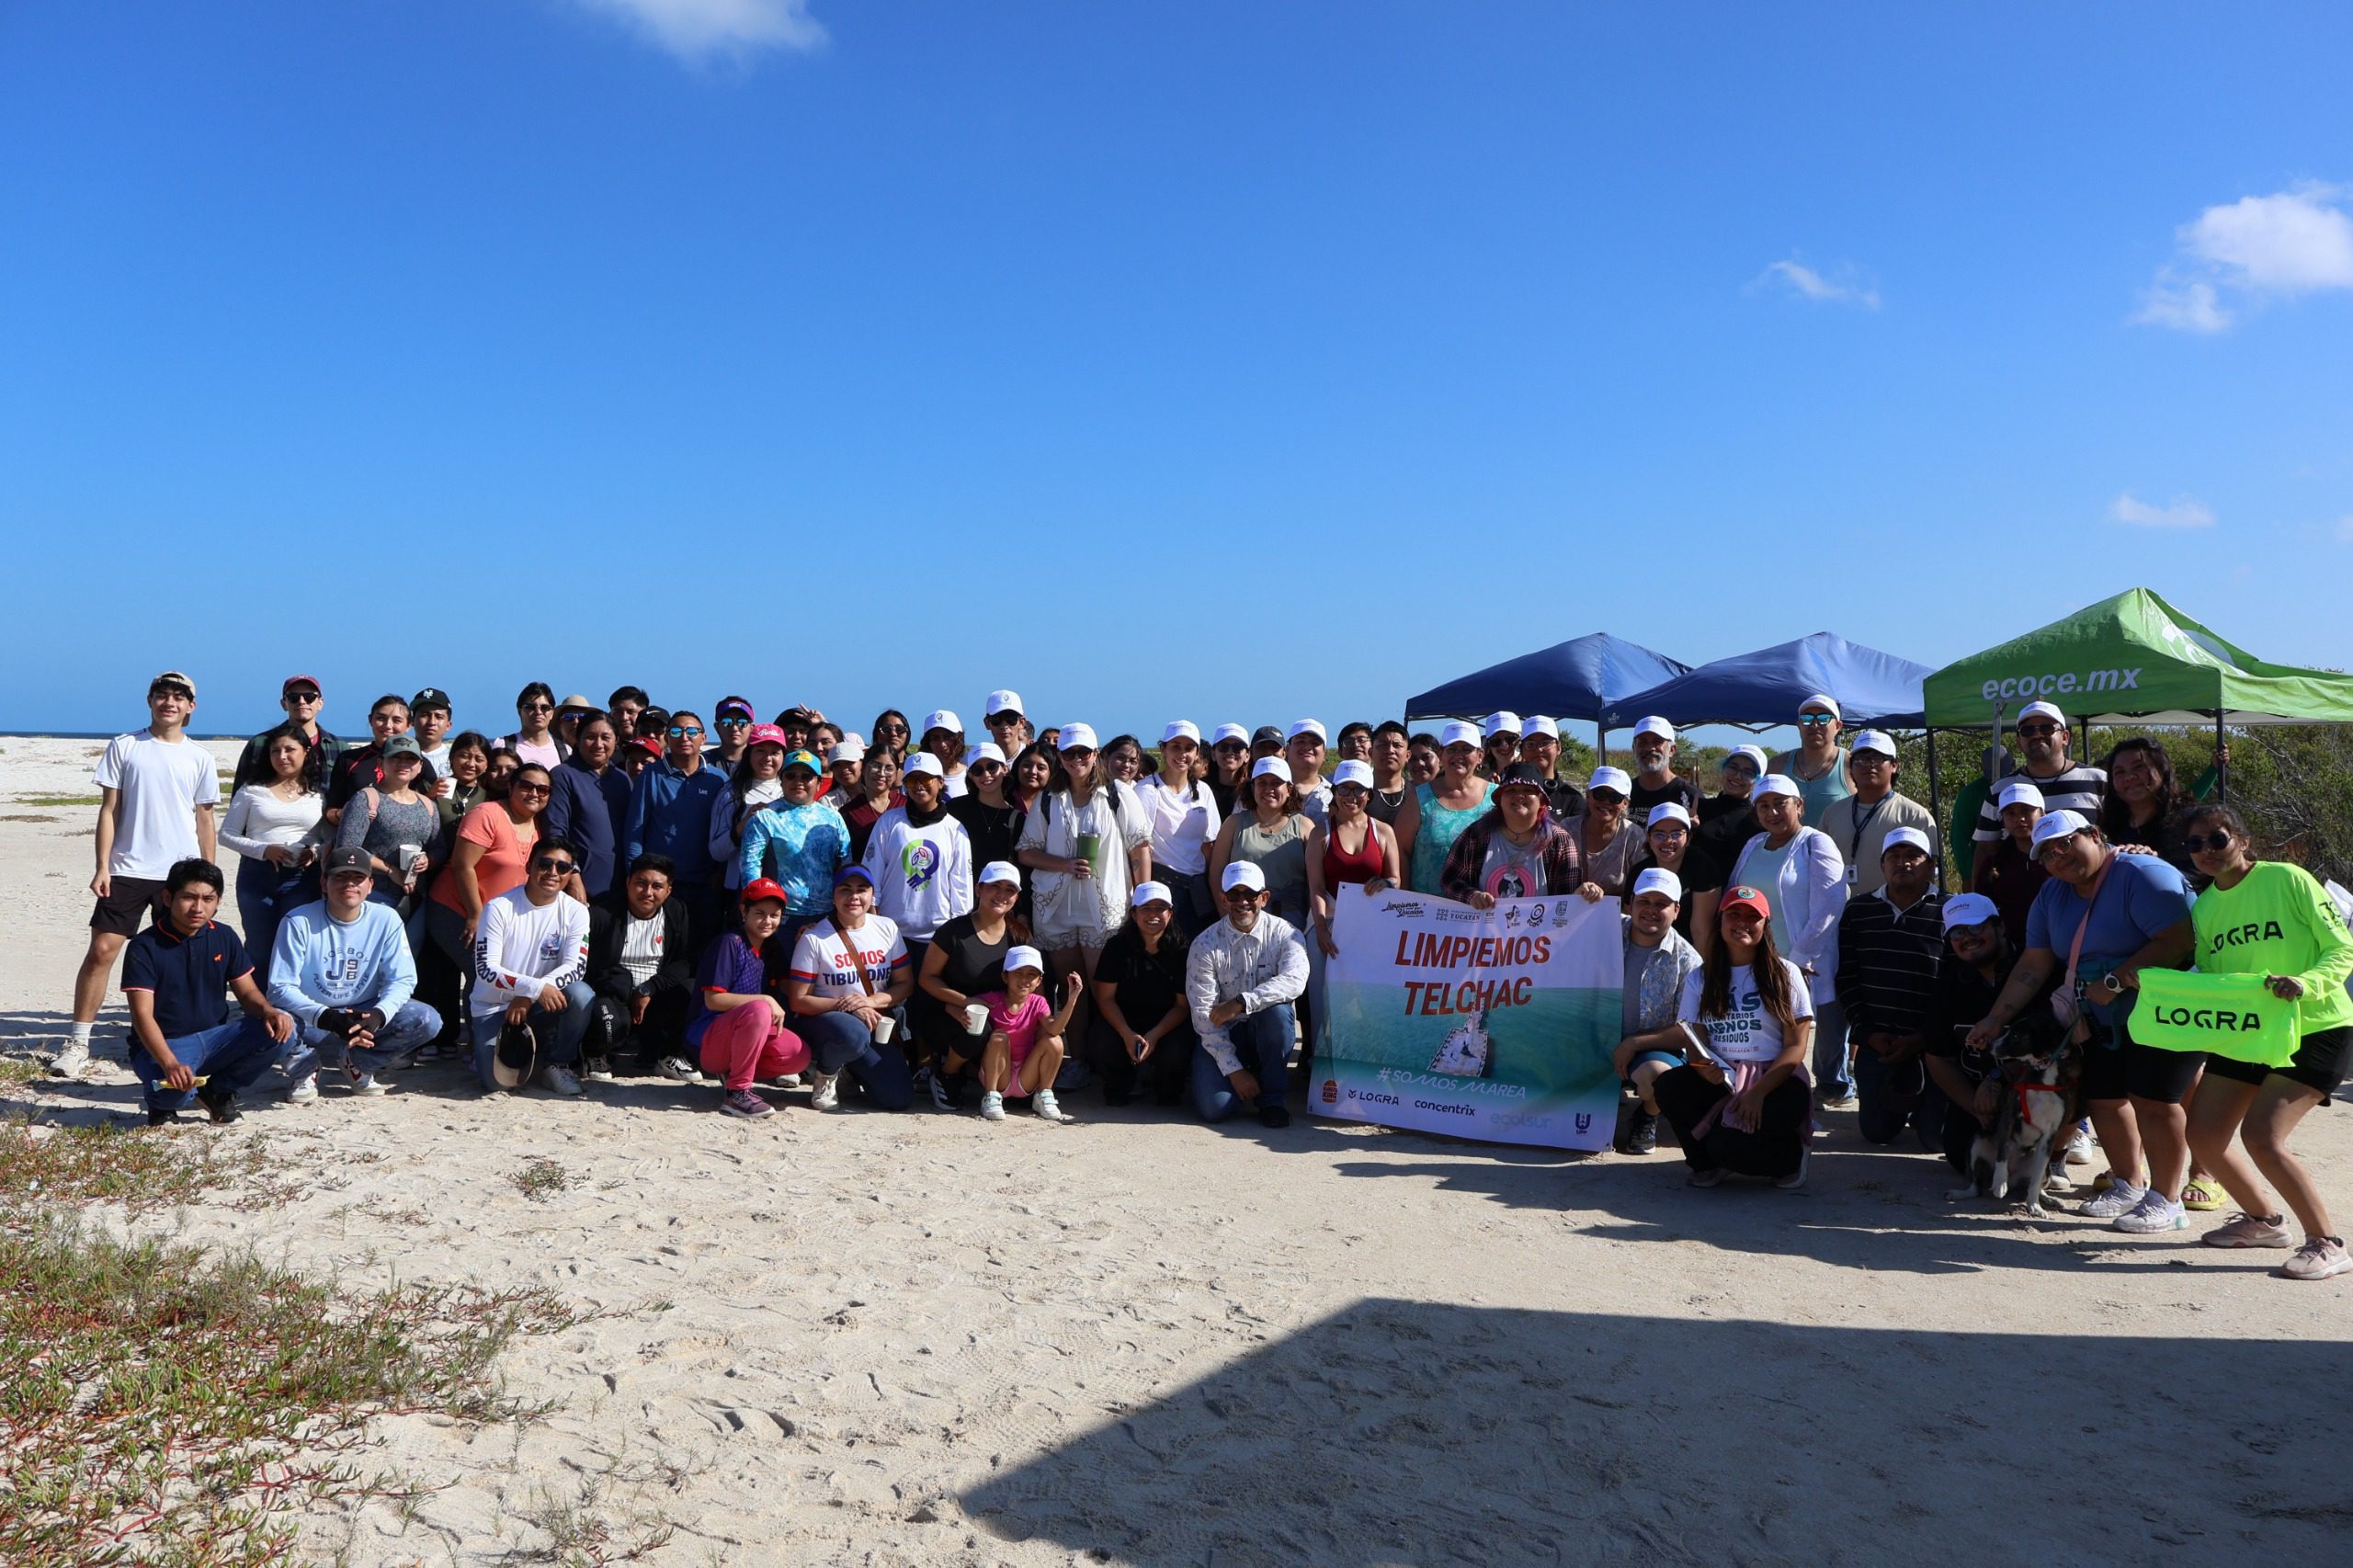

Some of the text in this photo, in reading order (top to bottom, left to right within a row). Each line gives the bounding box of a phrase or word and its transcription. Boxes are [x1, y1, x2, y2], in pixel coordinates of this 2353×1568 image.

[1982, 667, 2143, 700] ecoce.mx
[1394, 930, 1552, 969] LIMPIEMOS
[2210, 920, 2284, 955] LOGRA
[477, 937, 498, 983] COZUMEL
[1404, 976, 1533, 1016] TELCHAC
[2154, 1006, 2261, 1032] LOGRA
[1713, 1032, 1750, 1043] RESIDUOS
[1359, 1092, 1400, 1106] LOGRA
[1460, 1080, 1527, 1099] MAREA
[1415, 1100, 1476, 1118] concentrix
